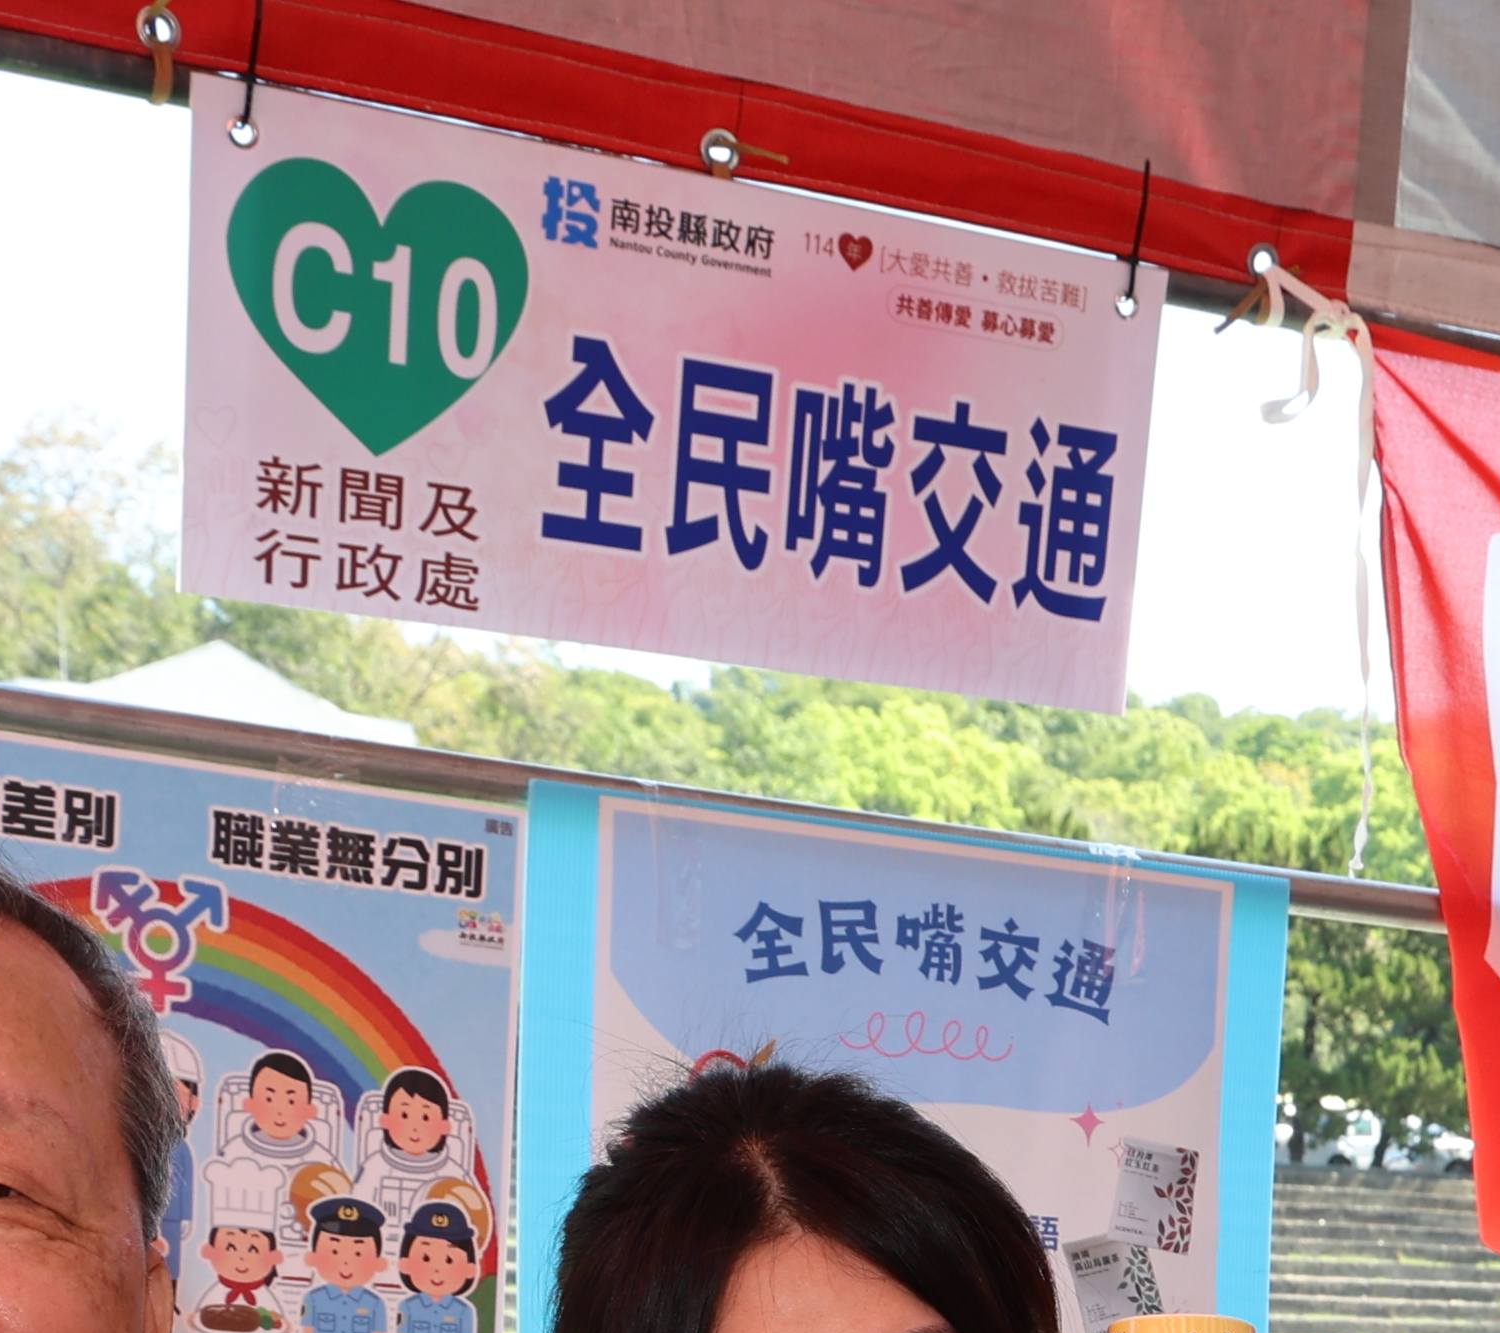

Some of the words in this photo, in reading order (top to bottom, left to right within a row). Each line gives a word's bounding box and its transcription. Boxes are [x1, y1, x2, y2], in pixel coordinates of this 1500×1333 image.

[610, 199, 775, 260] 南投縣政府
[610, 237, 651, 256] Nantou
[656, 244, 698, 266] County
[701, 252, 773, 278] Government
[271, 222, 500, 381] C10
[256, 457, 481, 541] 新聞及
[541, 335, 1118, 622] 全民嘴交通
[254, 528, 481, 613] 行政處
[211, 809, 486, 899] 職業無分別
[734, 896, 1119, 1026] 全民嘴交通
